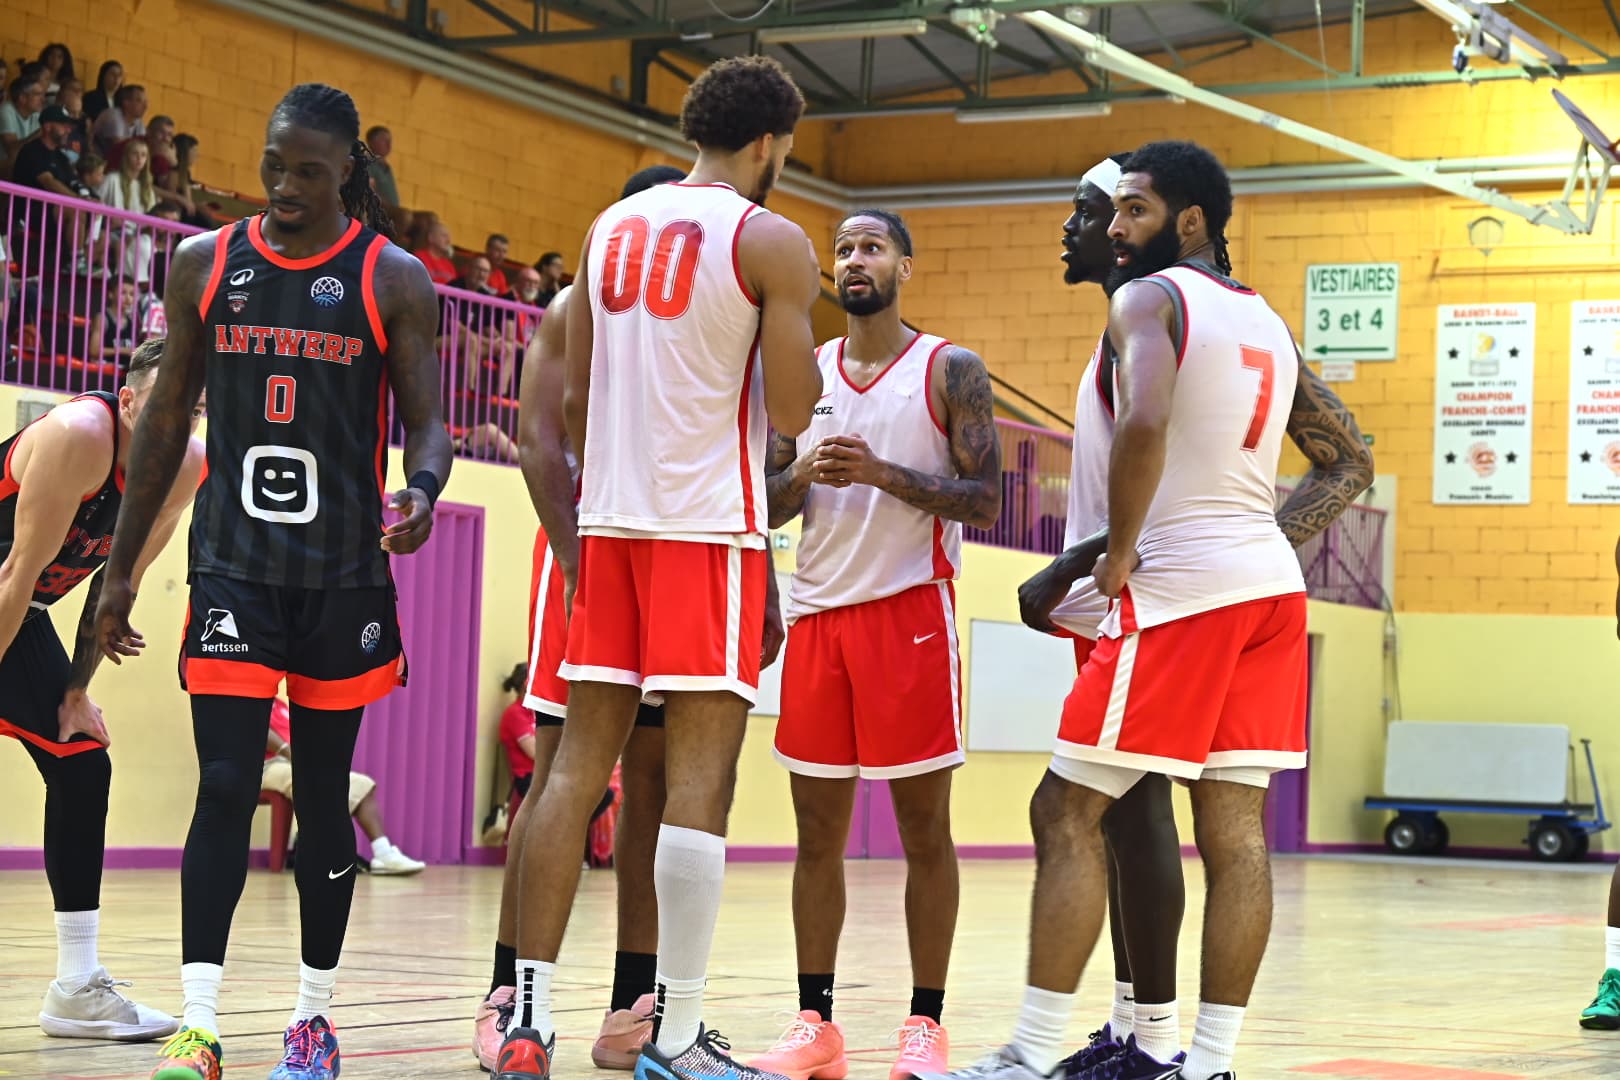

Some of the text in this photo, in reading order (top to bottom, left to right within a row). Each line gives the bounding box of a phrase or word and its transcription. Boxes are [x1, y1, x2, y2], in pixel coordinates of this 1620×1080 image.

[601, 214, 705, 320] 00
[1310, 267, 1395, 293] VESTIAIRES
[1318, 307, 1383, 331] 3 et 4
[215, 324, 363, 366] ANTWERP
[264, 374, 297, 425] 0
[1239, 343, 1275, 453] 7
[1456, 391, 1513, 402] CHAMPION
[201, 642, 249, 653] aertssen
